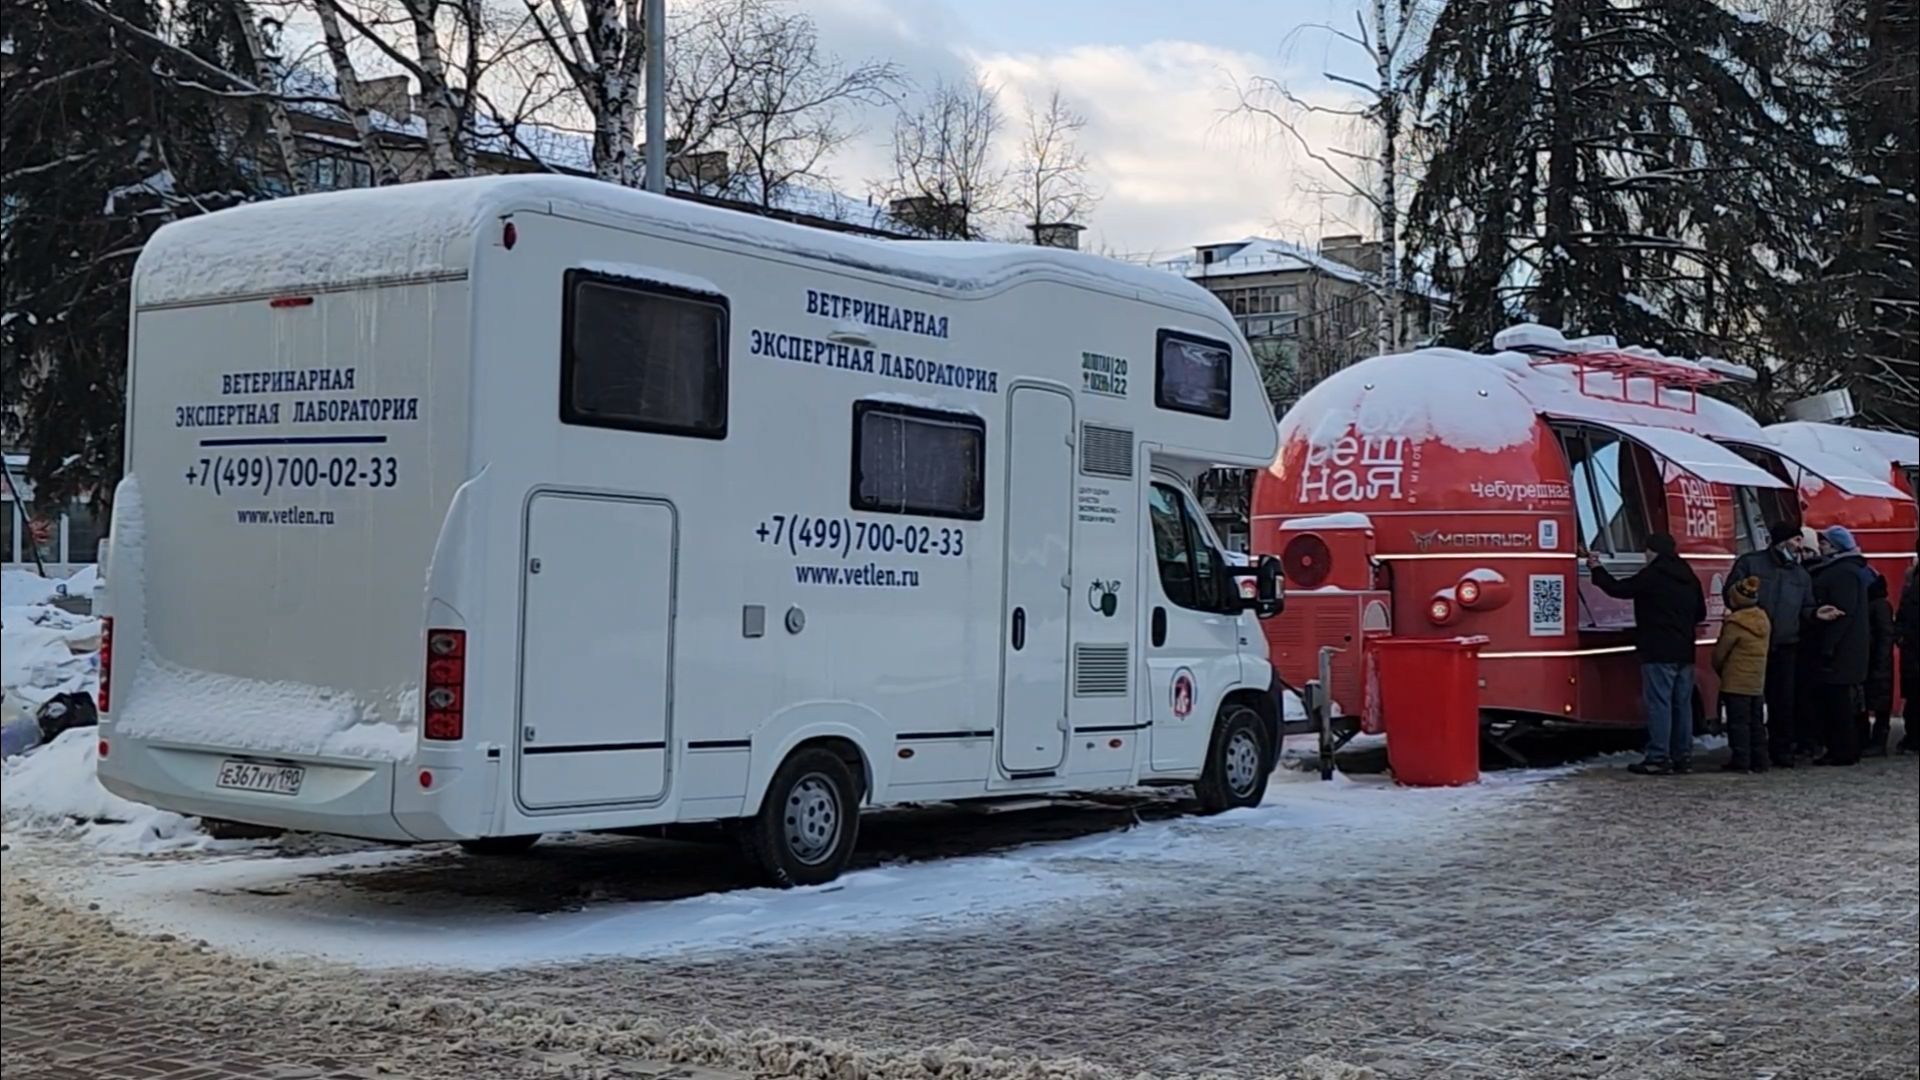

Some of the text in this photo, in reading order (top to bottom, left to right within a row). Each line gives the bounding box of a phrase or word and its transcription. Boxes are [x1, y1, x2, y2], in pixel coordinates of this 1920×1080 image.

[806, 289, 949, 339] ВЕТЕРИНАРНАЯ
[751, 329, 998, 393] ЭКСПЕРТНАЯ ЛАБОРАТОРИЯ
[1114, 358, 1128, 376] 20
[222, 368, 355, 394] ВЕТЕРИНАРНАЯ
[1114, 377, 1127, 395] 22
[176, 398, 418, 427] ЭКСПЕРТНАЯ ЛАБОРАТОРИЯ
[186, 456, 398, 496] +7(499)700-02-33
[1299, 467, 1403, 503] ная
[237, 506, 335, 525] www.vetlen.ru
[756, 514, 963, 559] +7(499)700-02-33
[1438, 533, 1532, 547] MOBITRUCK
[796, 563, 919, 587] www.vetlen.ru
